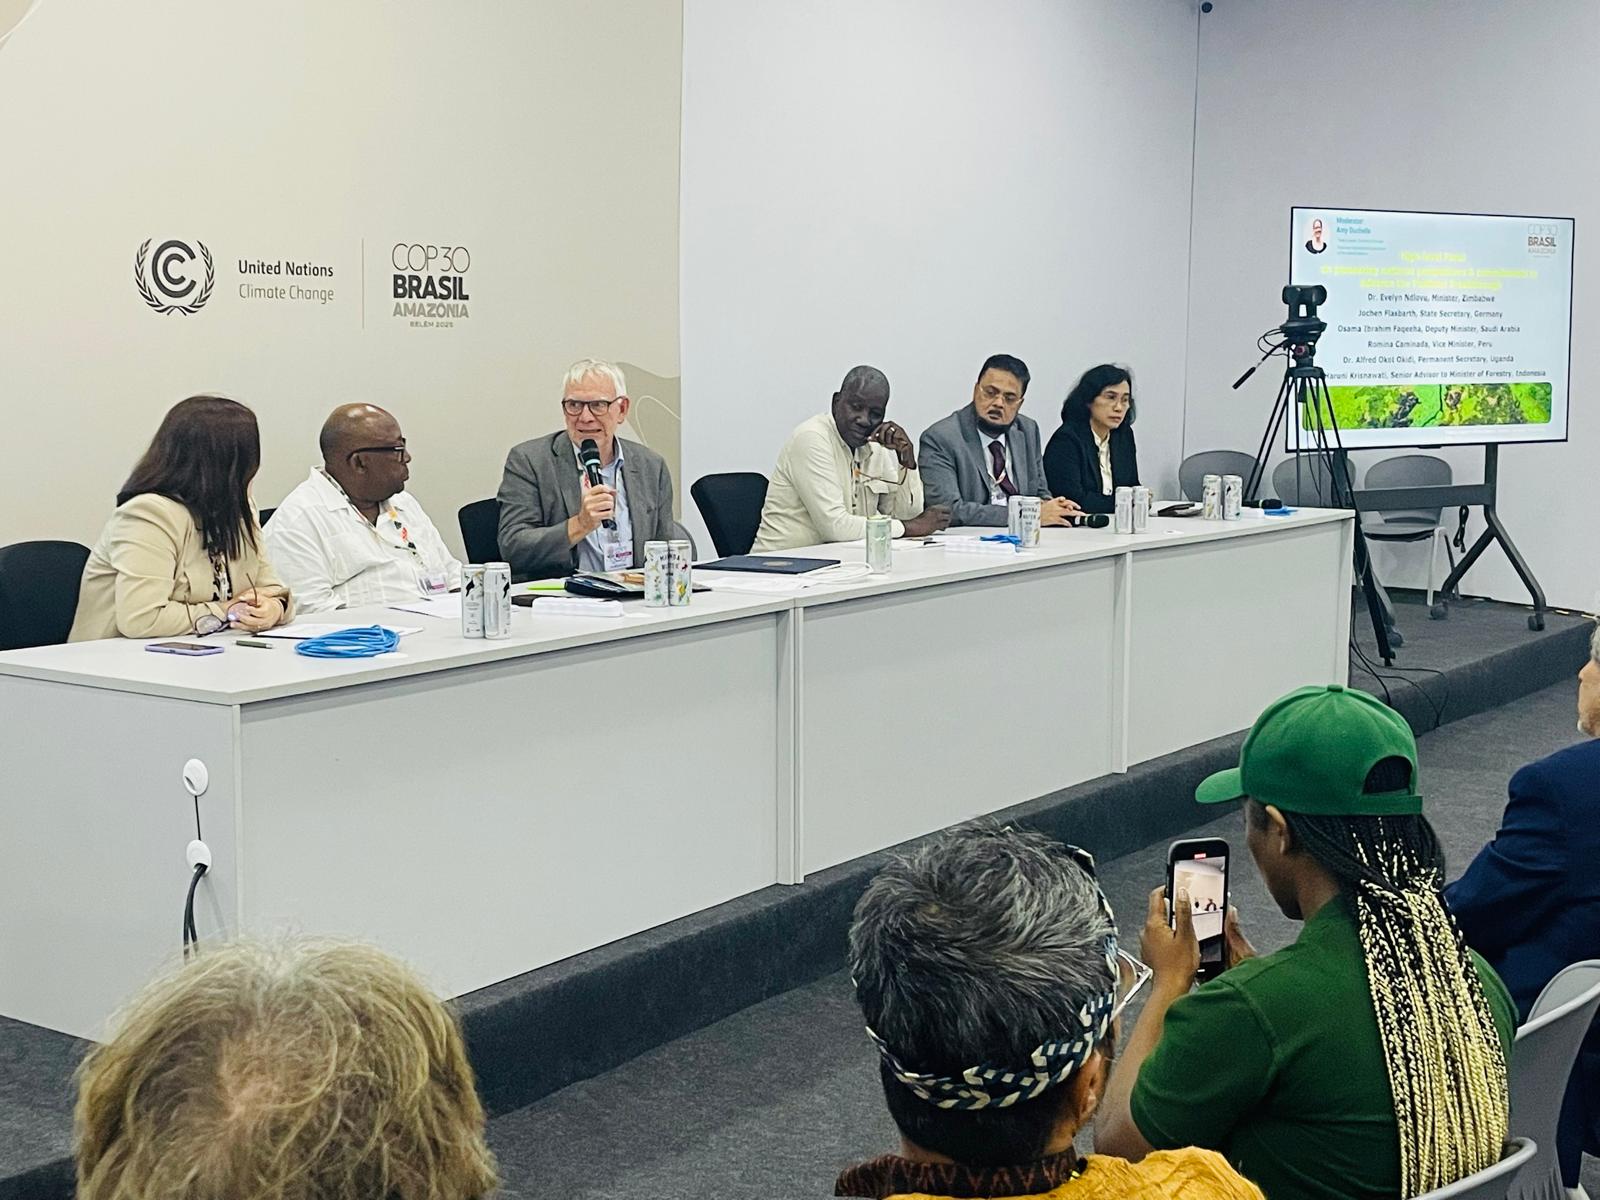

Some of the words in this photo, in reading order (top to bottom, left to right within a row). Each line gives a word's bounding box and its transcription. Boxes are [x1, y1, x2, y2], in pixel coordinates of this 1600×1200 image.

[1528, 236, 1556, 248] BRASIL
[392, 243, 470, 274] COP30
[238, 259, 280, 274] United
[286, 262, 334, 277] Nations
[393, 274, 470, 300] BRASIL
[239, 283, 286, 299] Climate
[290, 284, 334, 304] Change
[1380, 294, 1402, 302] Evelyn
[1462, 294, 1495, 302] Zimbabwe
[1440, 310, 1472, 318] Secretary,
[1474, 310, 1503, 318] Germany
[1425, 325, 1448, 334] Deputy
[1450, 326, 1478, 334] Minister,
[1448, 340, 1476, 348] Minister,
[1456, 355, 1488, 364] Secretary,
[1490, 355, 1514, 364] Uganda
[1486, 370, 1513, 378] Forestry,
